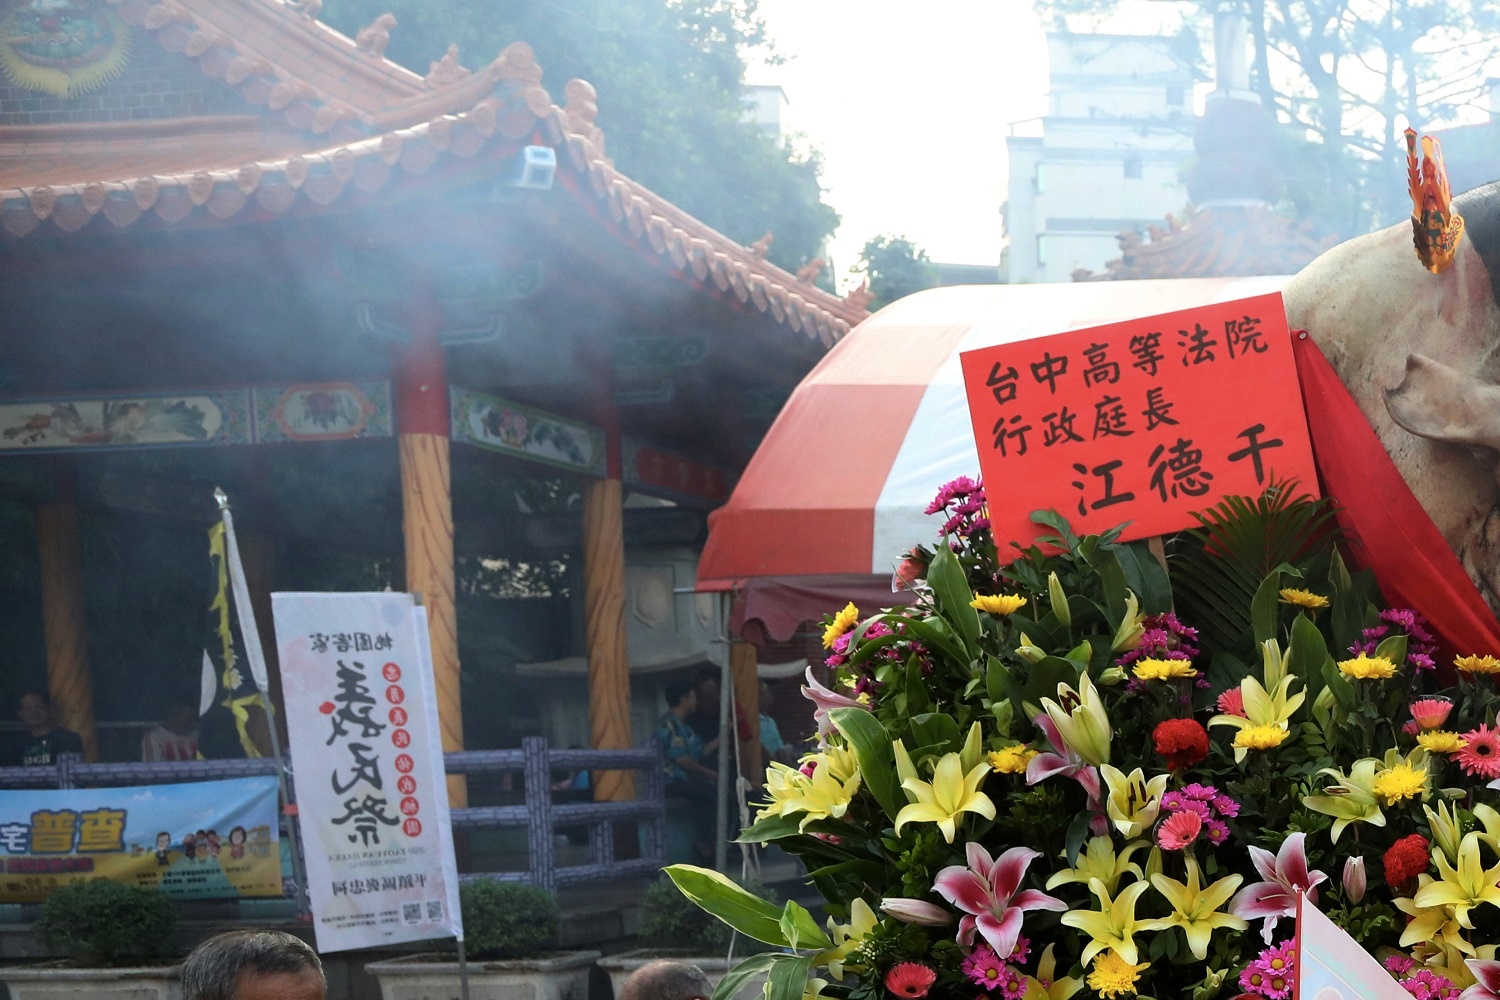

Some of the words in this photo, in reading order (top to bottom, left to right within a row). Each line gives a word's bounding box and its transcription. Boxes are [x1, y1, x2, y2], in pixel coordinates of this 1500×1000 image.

[985, 316, 1270, 406] 台中高等法院
[992, 386, 1180, 458] 行政庭長
